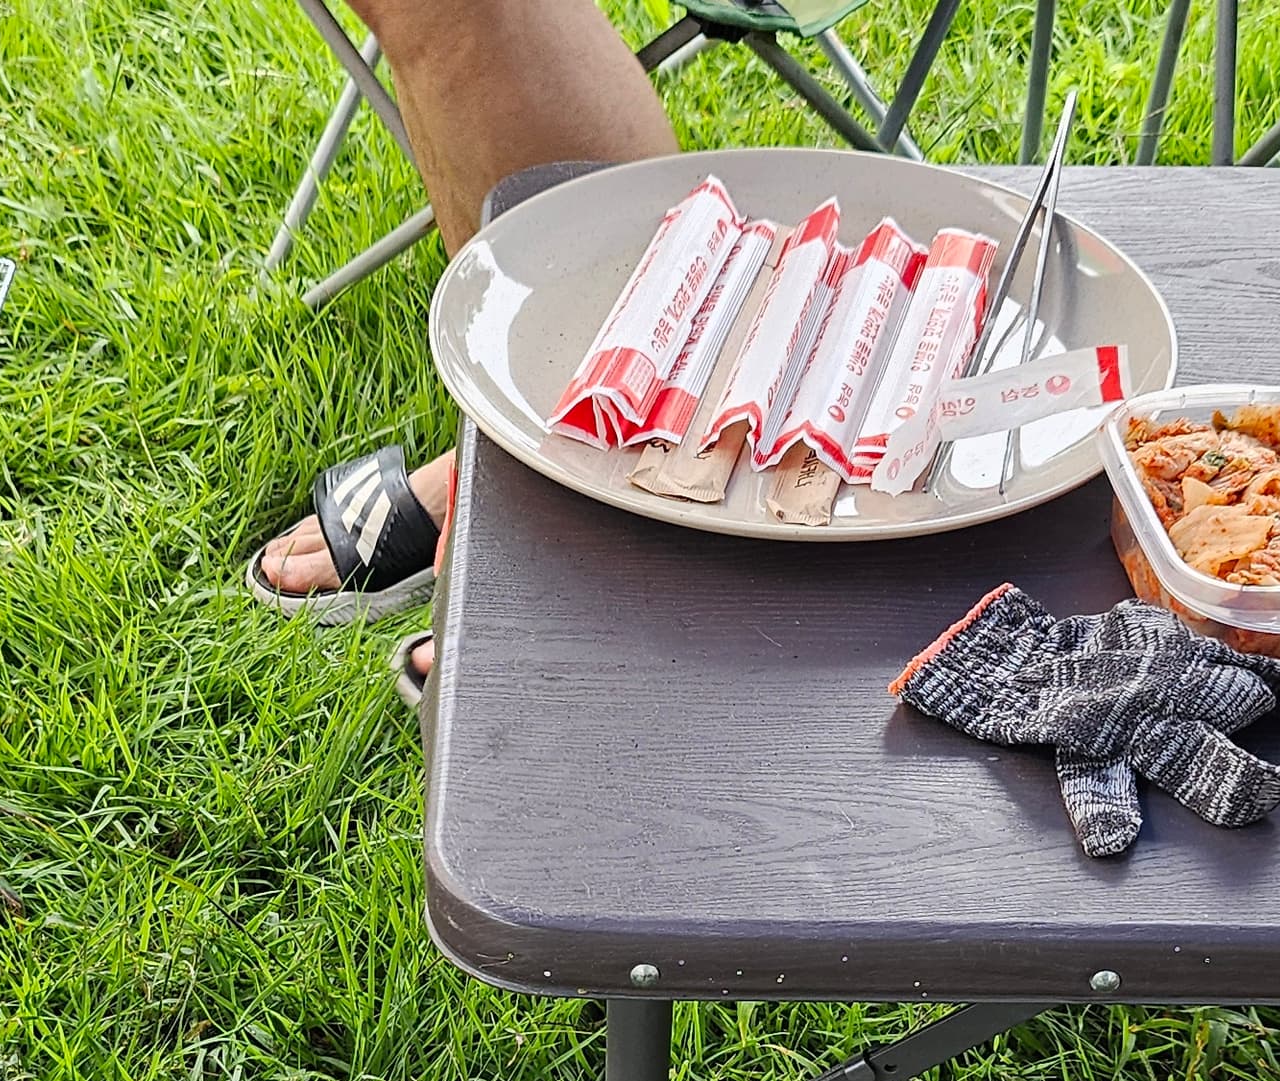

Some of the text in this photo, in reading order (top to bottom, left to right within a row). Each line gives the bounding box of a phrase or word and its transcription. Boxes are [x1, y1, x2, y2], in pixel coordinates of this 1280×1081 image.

[910, 341, 939, 372] 인생을
[837, 383, 854, 408] 농심
[847, 341, 873, 375] 인생을
[904, 384, 923, 406] 농심
